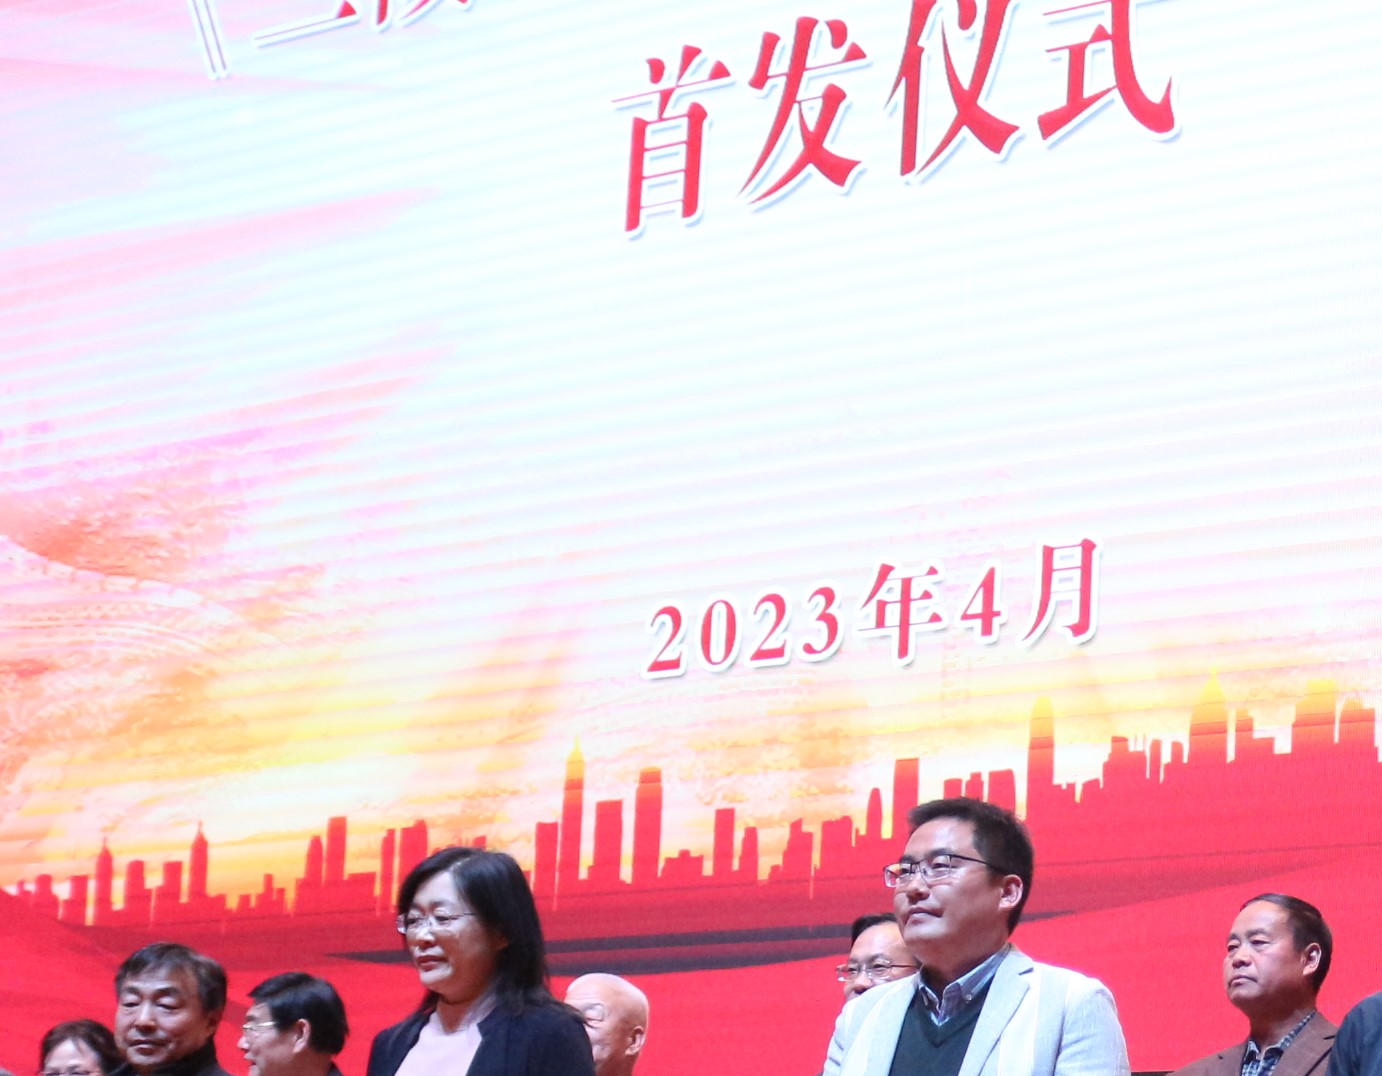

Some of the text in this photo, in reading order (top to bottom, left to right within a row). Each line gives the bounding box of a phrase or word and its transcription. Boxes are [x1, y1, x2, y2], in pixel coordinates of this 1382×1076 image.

[609, 0, 1177, 234] 首发仪式
[645, 537, 1099, 674] 2023年4月
